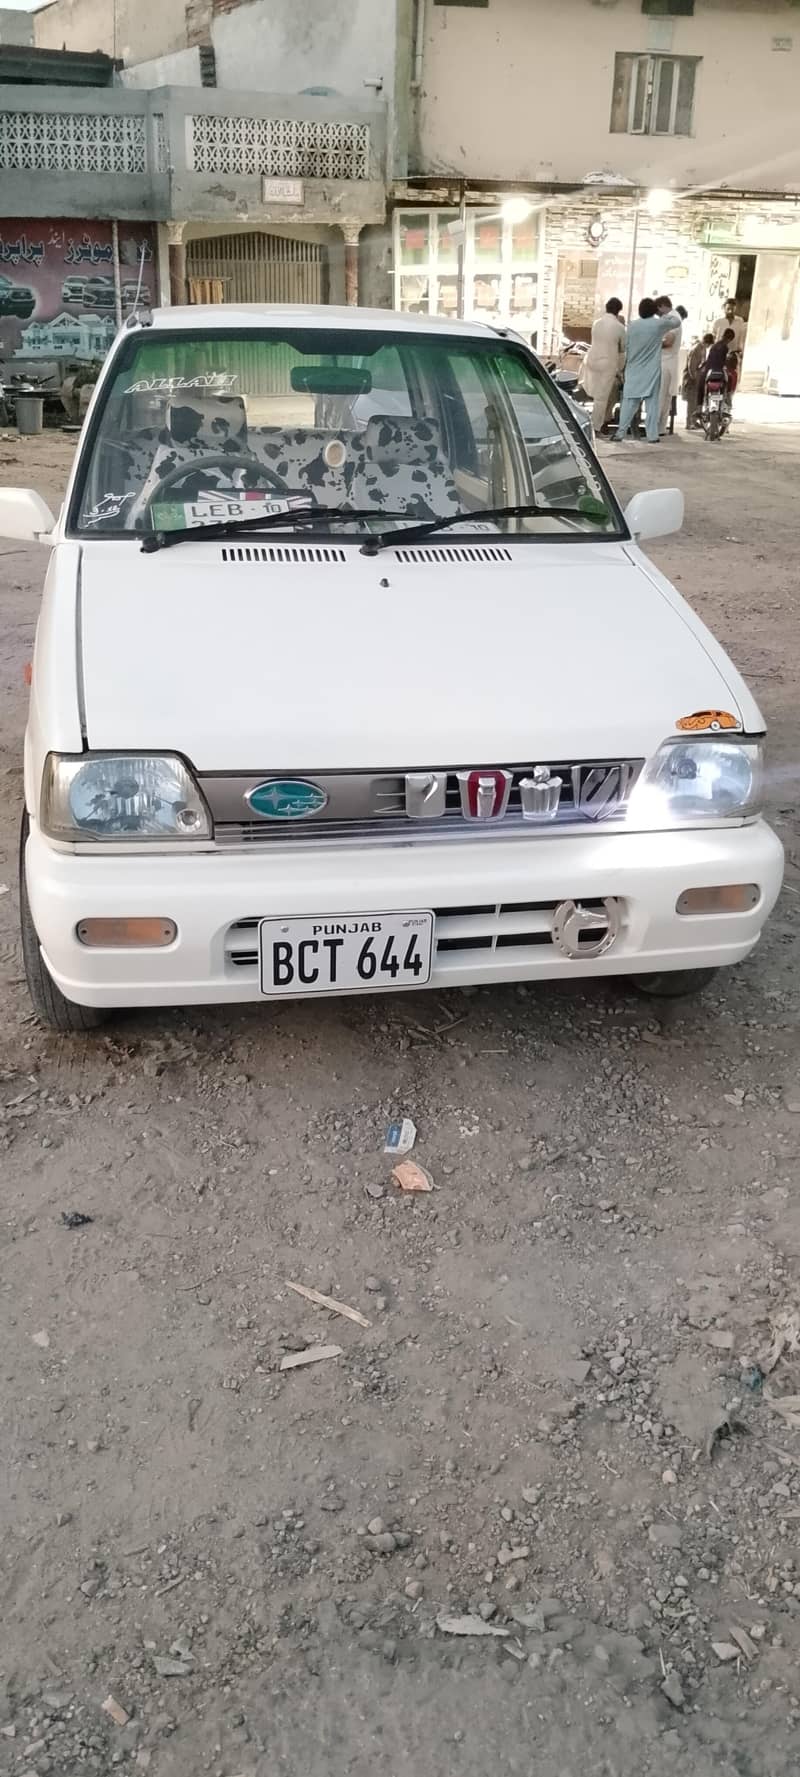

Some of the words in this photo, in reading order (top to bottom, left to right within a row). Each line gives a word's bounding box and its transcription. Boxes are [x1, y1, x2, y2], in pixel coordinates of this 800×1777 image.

[191, 503, 243, 518] LEB
[262, 502, 281, 513] 10
[312, 922, 382, 936] PUNJAB
[273, 938, 345, 986] BCT
[356, 934, 423, 980] 644
